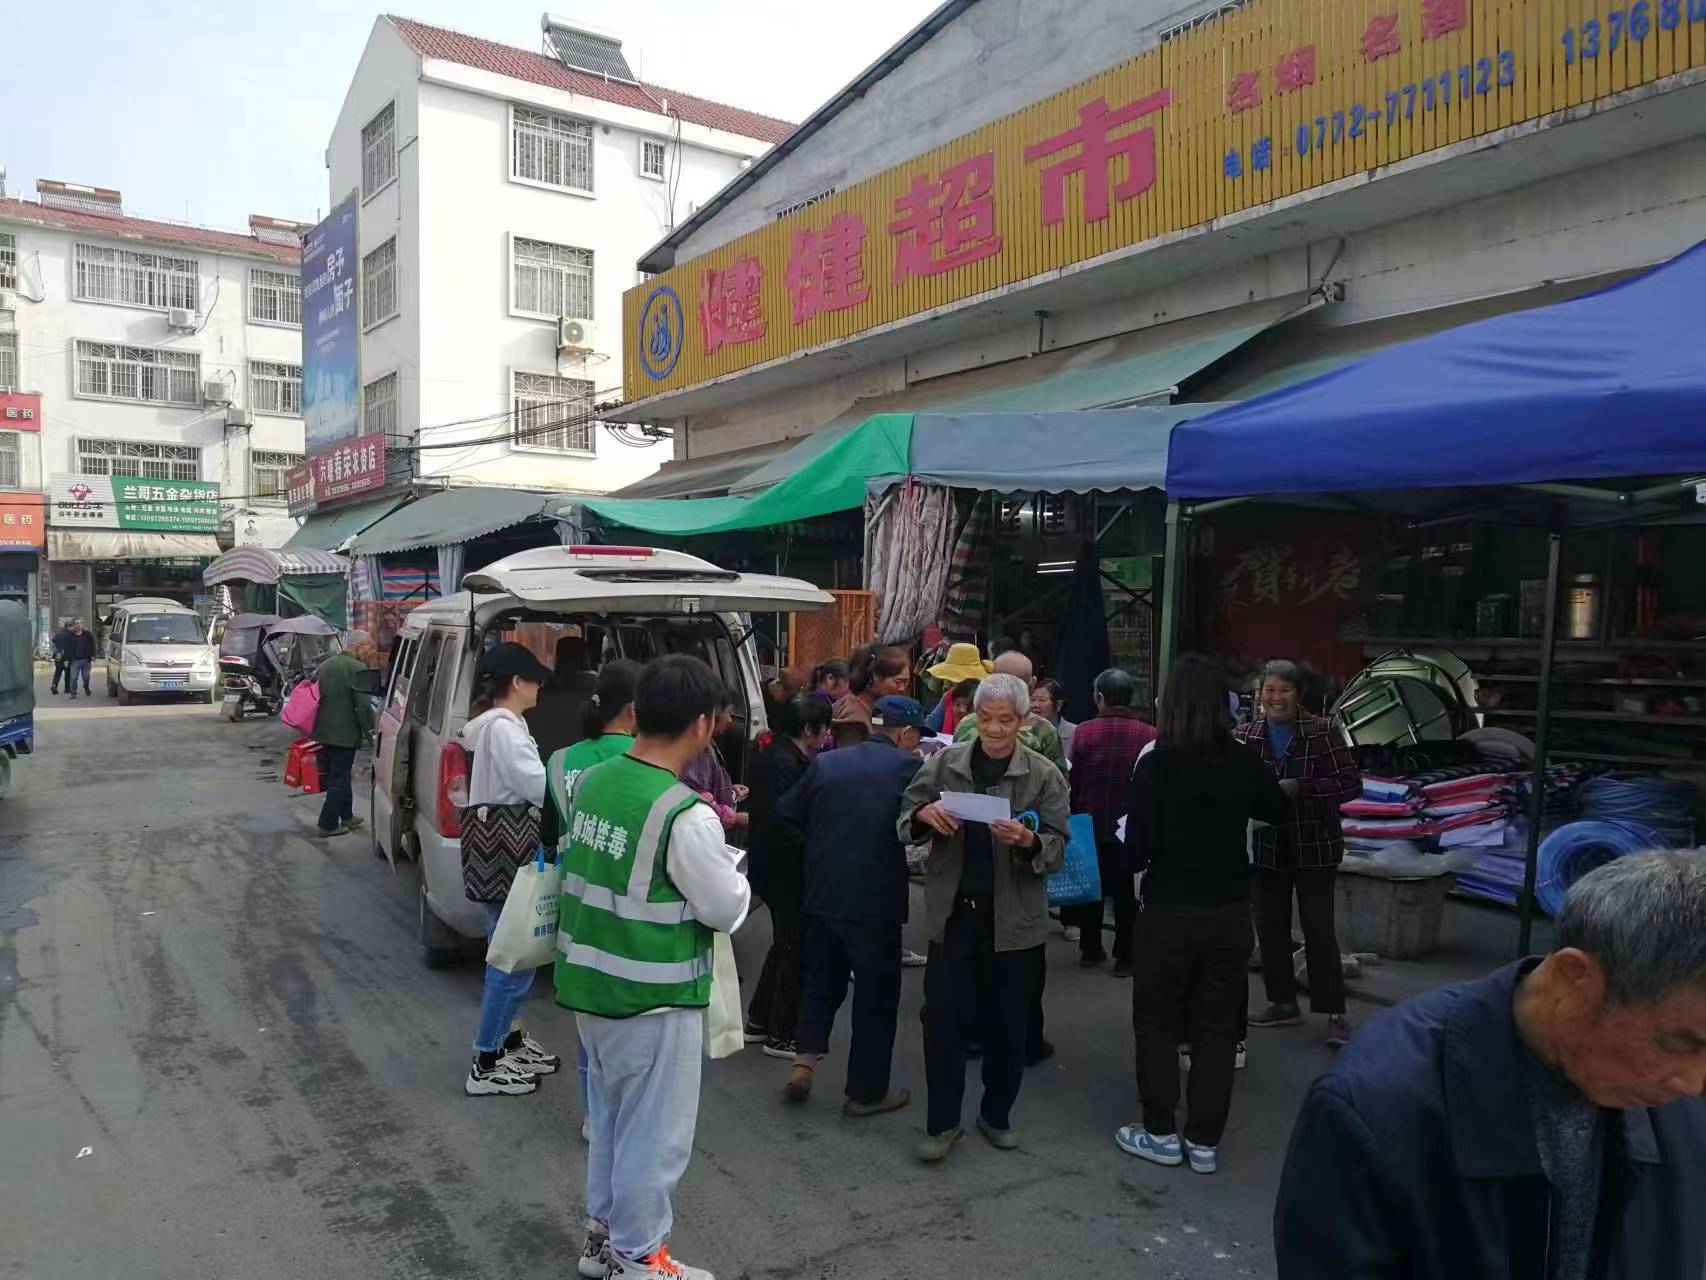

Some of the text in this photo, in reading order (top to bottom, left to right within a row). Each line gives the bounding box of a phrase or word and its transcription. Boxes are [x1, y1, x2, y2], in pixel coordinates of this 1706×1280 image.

[1227, 44, 1316, 112] 名烟
[697, 87, 1172, 357] 健健超市
[123, 485, 219, 504] 兰哥五金杂货店
